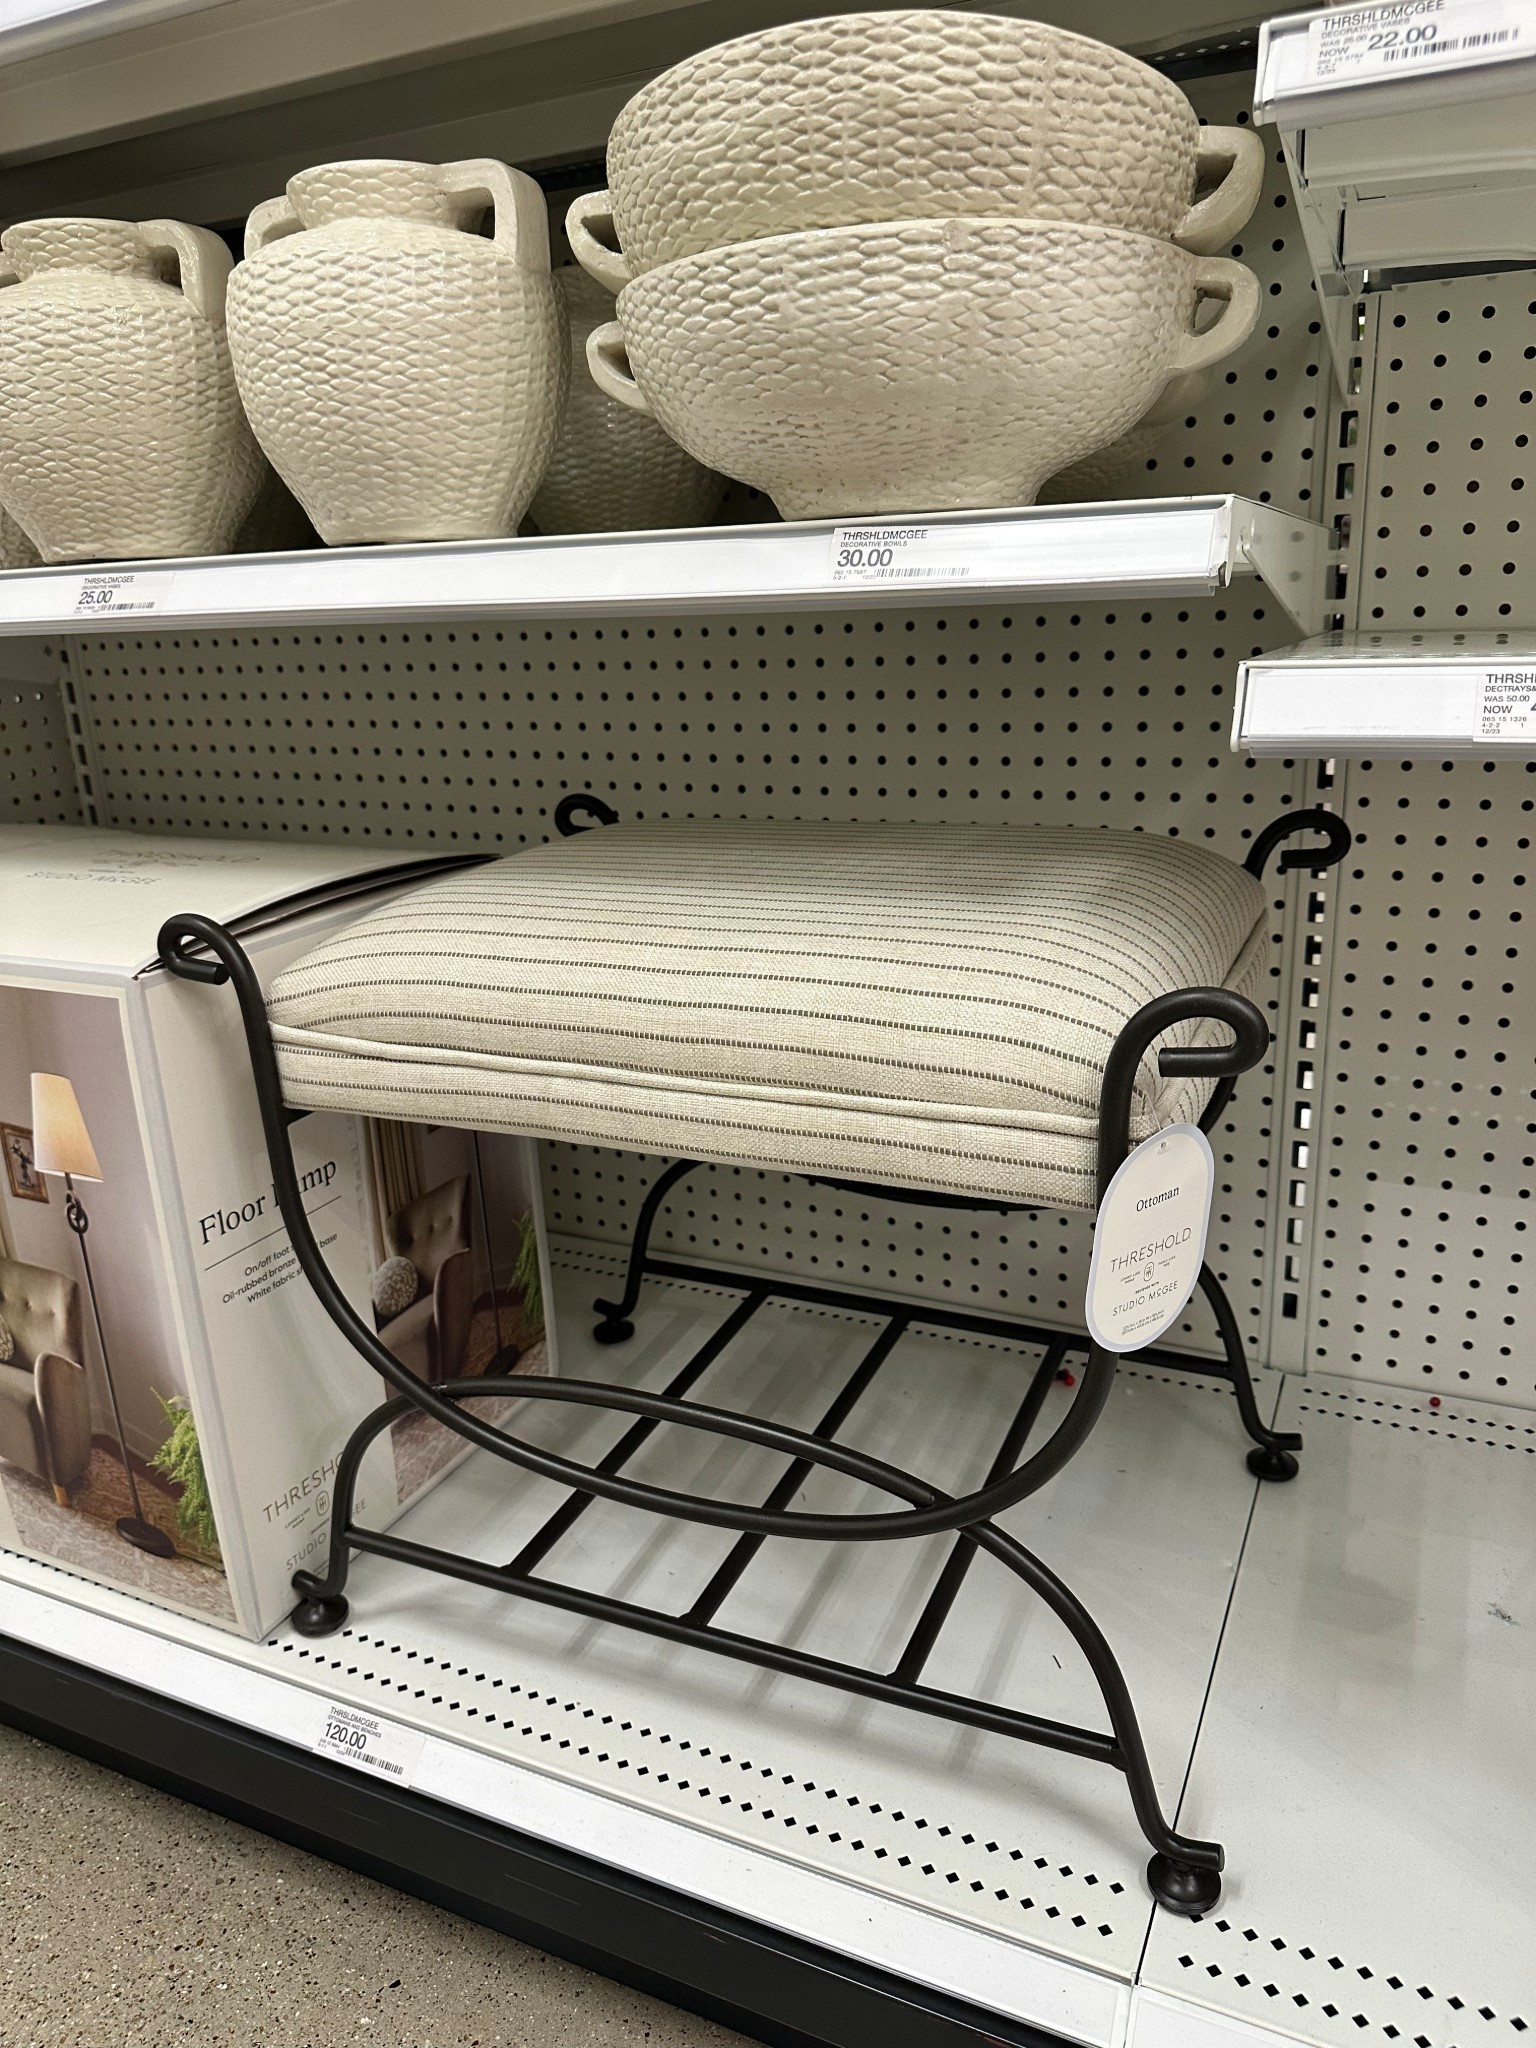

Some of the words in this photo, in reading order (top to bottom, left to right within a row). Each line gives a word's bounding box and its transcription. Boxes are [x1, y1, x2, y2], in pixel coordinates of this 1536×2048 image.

[1322, 0, 1445, 30] THRSHLDMCGEE
[1321, 24, 1378, 39] DECORATIVE
[1380, 17, 1410, 28] VASES
[1319, 46, 1349, 58] NOW
[1367, 24, 1437, 51] 22.00
[1320, 40, 1340, 48] WAS
[842, 529, 928, 541] THRSHLDMCGEE
[837, 548, 893, 567] 30.00
[84, 575, 135, 585] THRSHLDMCGEE
[78, 590, 113, 604] 25.00
[1486, 673, 1536, 684] THRSH
[1483, 705, 1513, 714] NOW
[199, 1195, 266, 1245] Floor
[271, 1161, 336, 1208] Lmp
[1136, 1186, 1180, 1212] Ottoman
[244, 1256, 271, 1276] On/off
[273, 1245, 290, 1260] foot
[319, 1233, 338, 1248] base
[1110, 1226, 1193, 1273] THRESHOLD
[222, 1273, 268, 1303] Oil-rubbed
[268, 1257, 297, 1278] bronze
[247, 1284, 271, 1303] White
[272, 1271, 296, 1289] fabric
[1112, 1295, 1146, 1317] STUDIO
[286, 1532, 327, 1571] STUDIO
[330, 1706, 379, 1730] THRSLDMCGEE
[325, 1721, 367, 1750] 120.00
